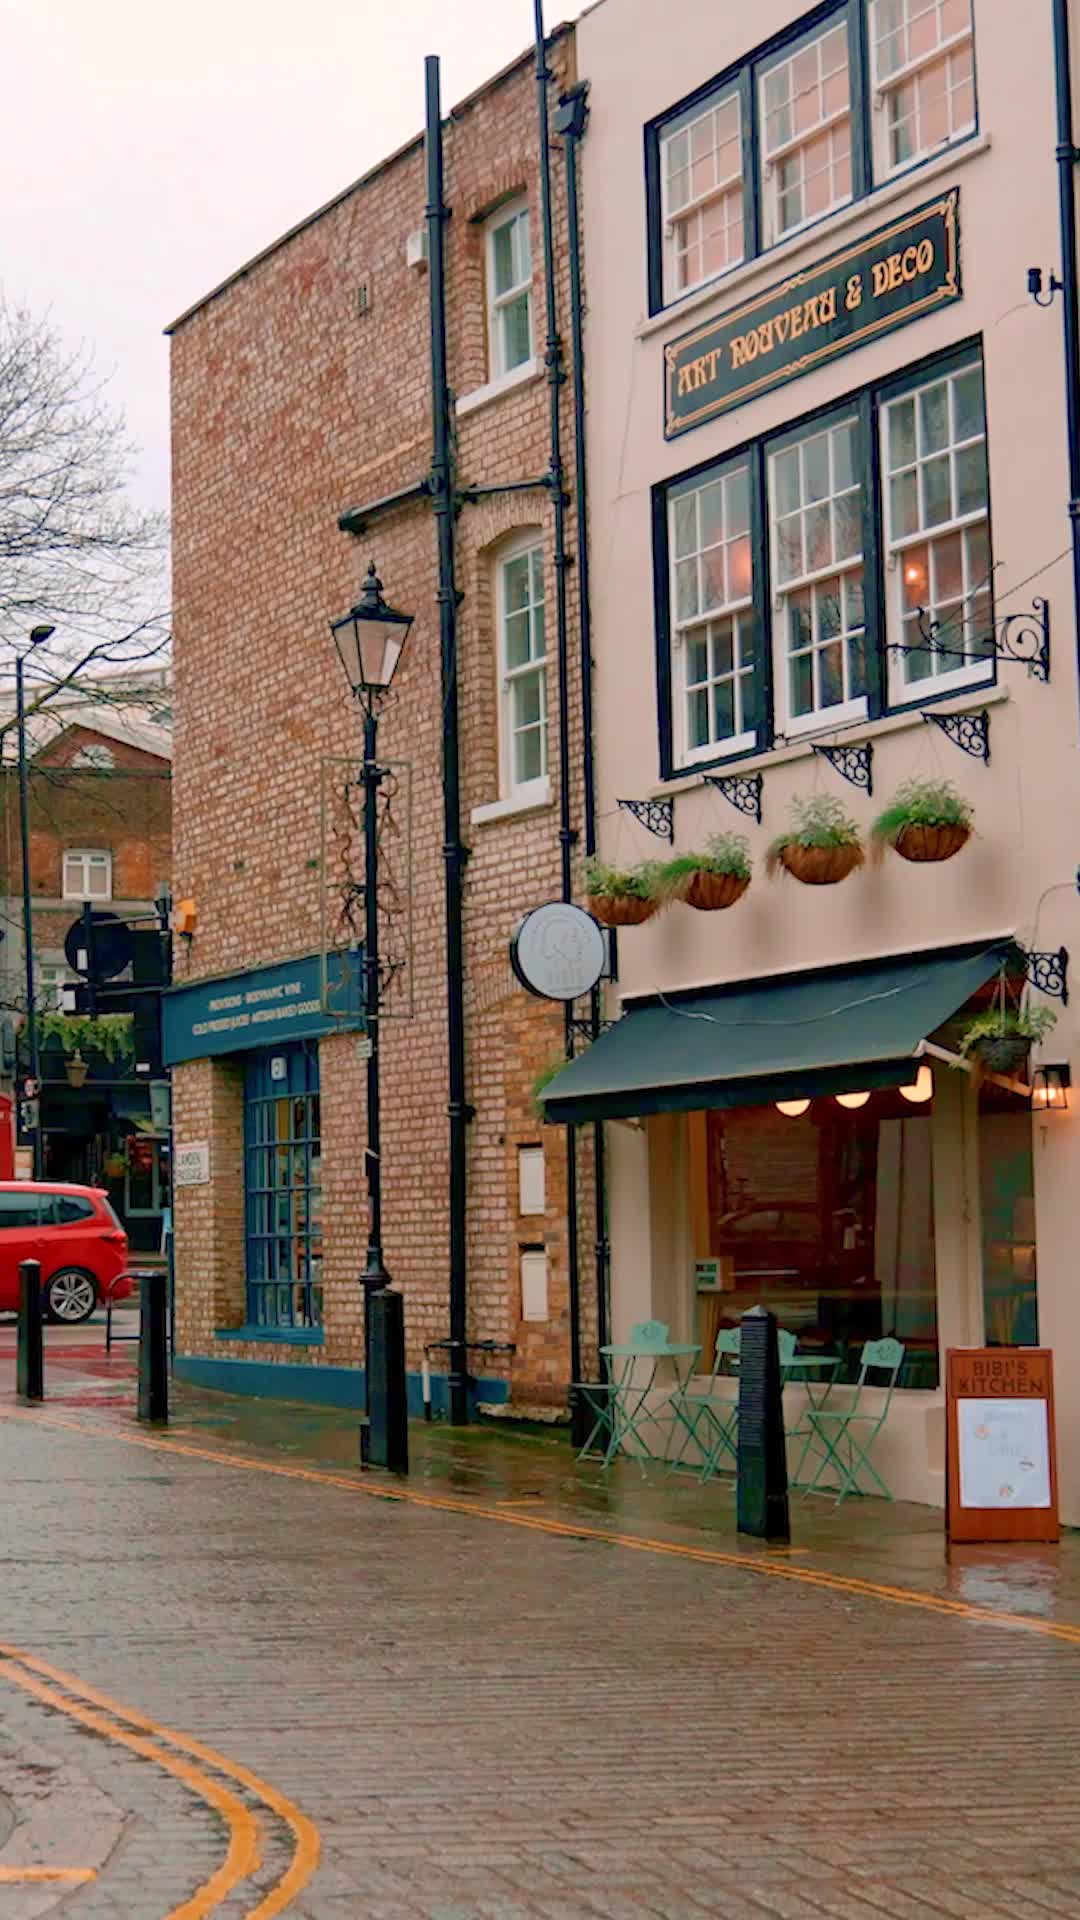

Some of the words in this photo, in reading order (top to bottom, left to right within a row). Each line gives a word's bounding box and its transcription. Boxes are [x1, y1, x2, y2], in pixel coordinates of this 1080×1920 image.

[677, 348, 722, 397] ART
[729, 287, 837, 369] NOUVEAU
[845, 274, 862, 311] &
[872, 239, 934, 297] DECO
[973, 1359, 1028, 1376] BIBI'S
[959, 1377, 1043, 1393] KITCHEN
